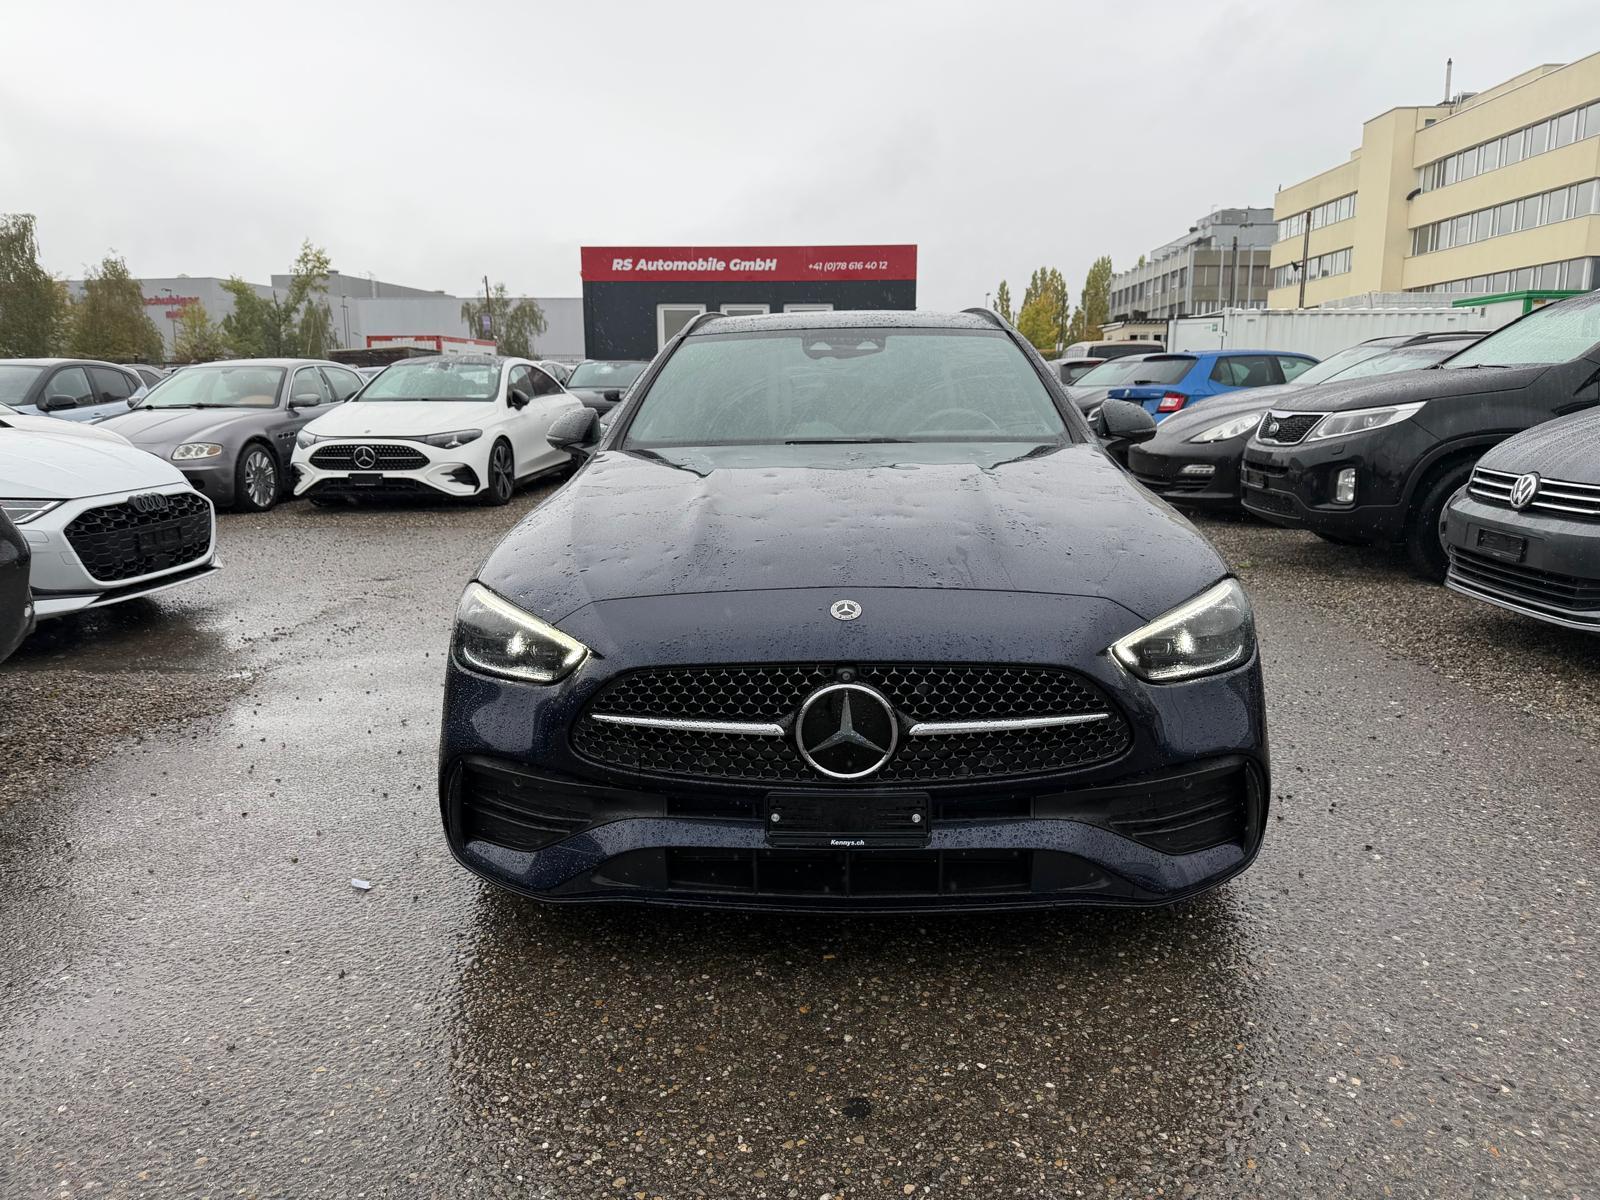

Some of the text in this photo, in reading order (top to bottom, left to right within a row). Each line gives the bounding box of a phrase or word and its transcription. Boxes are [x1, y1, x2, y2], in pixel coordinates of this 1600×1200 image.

[612, 257, 777, 271] RS Automobile GmbH
[808, 261, 888, 271] +41 (0)78 616 40 12
[831, 839, 865, 847] Kennys.ch
